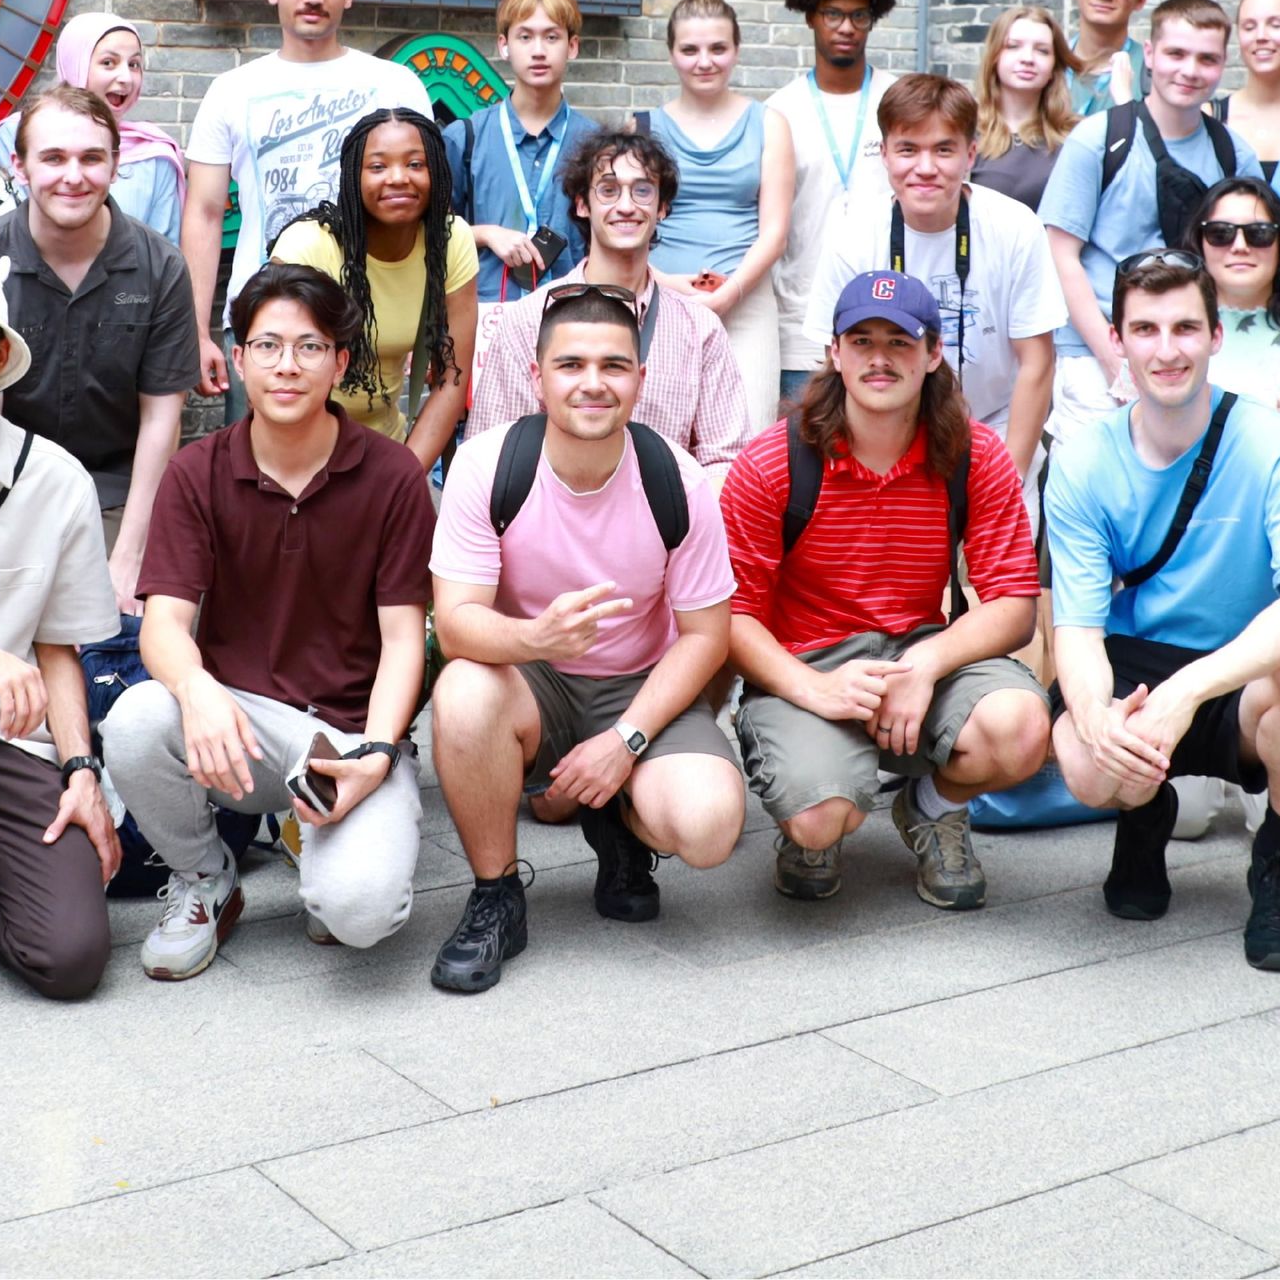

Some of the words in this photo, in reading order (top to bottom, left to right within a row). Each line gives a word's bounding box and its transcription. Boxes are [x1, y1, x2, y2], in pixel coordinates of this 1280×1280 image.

[260, 109, 293, 145] Los
[297, 89, 368, 125] Angeles
[264, 167, 298, 194] 1984
